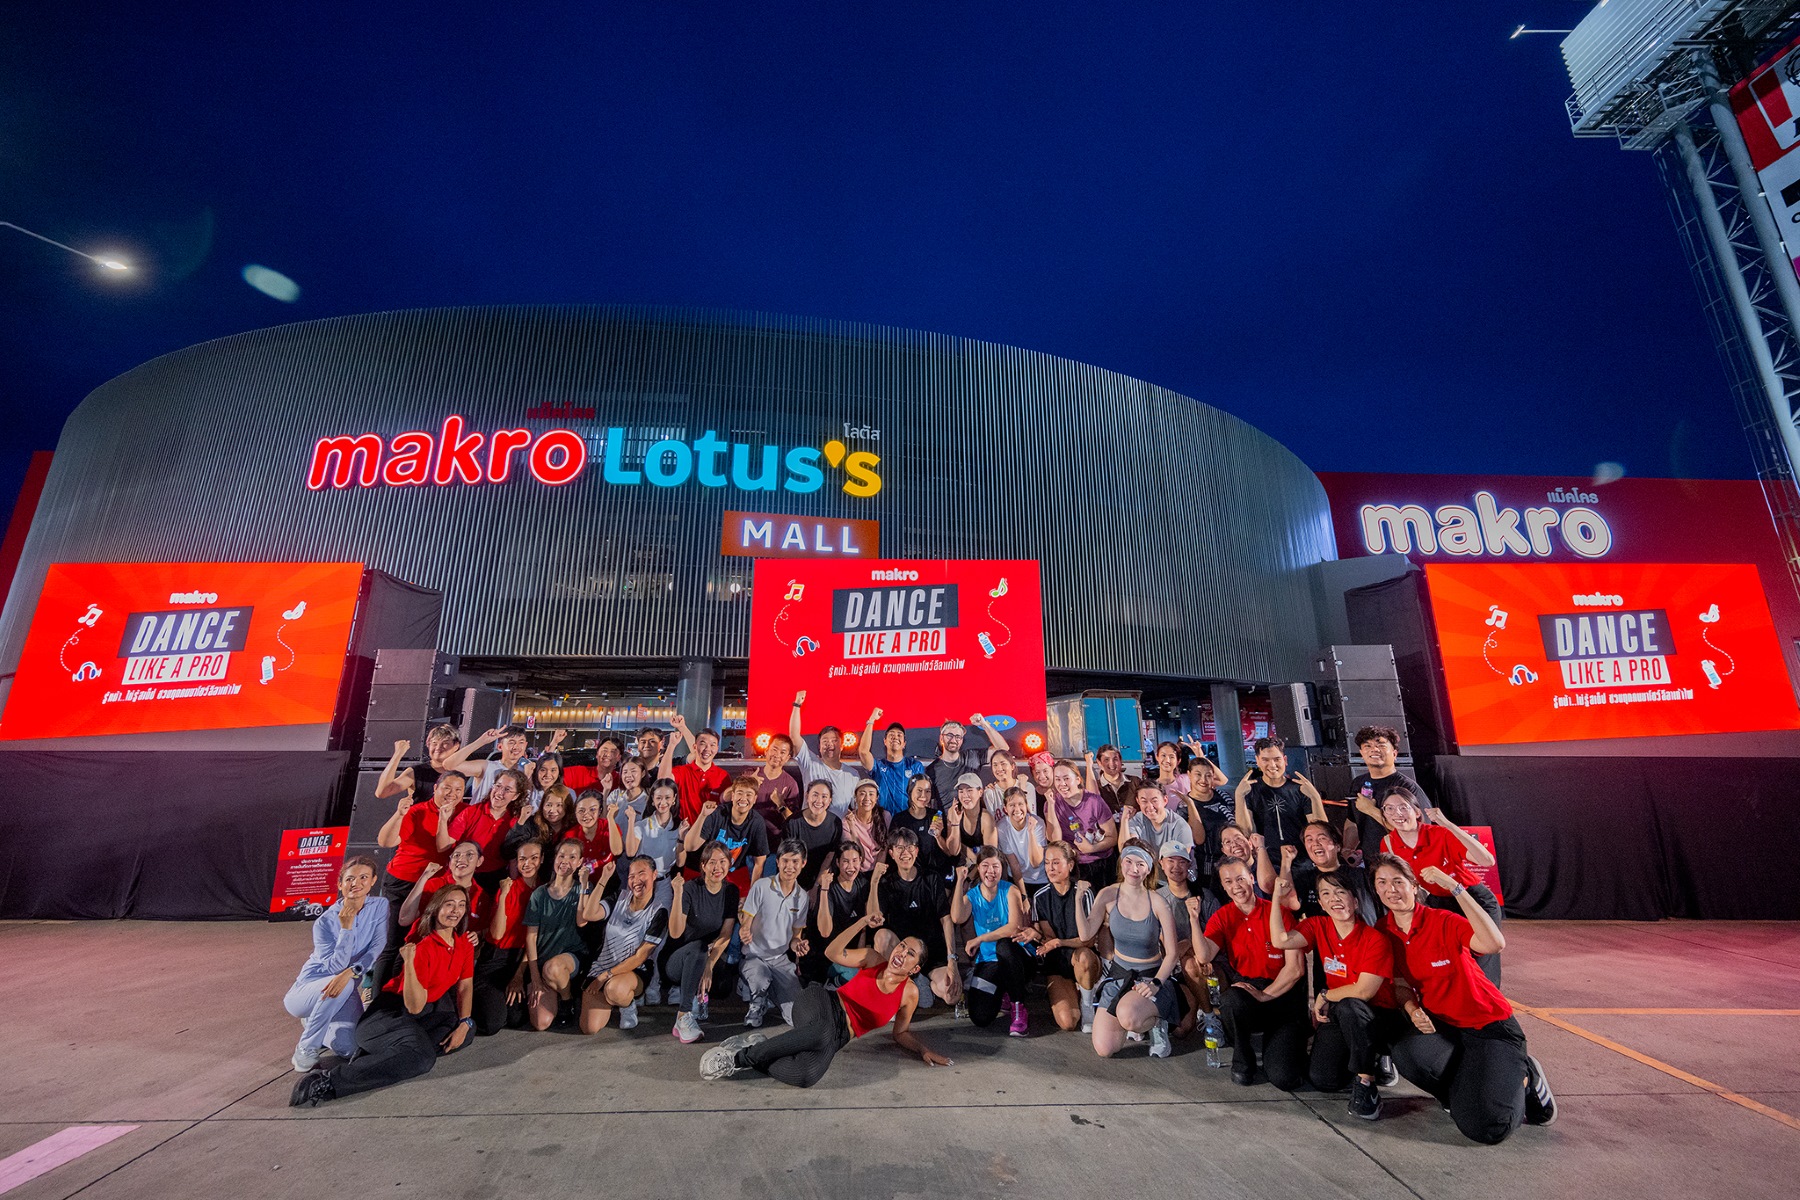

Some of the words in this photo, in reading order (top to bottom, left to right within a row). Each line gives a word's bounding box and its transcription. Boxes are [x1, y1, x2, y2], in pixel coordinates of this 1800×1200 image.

[843, 423, 881, 441] โลตัส
[307, 414, 587, 491] makro
[602, 426, 882, 498] Lotus's
[1546, 487, 1599, 504] แม็คโคร
[742, 519, 860, 554] MALL
[1360, 491, 1613, 558] makro
[870, 568, 919, 582] makro
[169, 590, 218, 604] makro
[844, 588, 945, 629] DANCE
[1572, 592, 1624, 606] makro
[131, 611, 240, 653] DANCE
[849, 632, 886, 655] LIKE
[891, 632, 901, 653] A
[908, 630, 941, 653] PRO
[1555, 613, 1658, 656] DANCE
[128, 657, 167, 681] LIKE
[171, 656, 183, 678] A
[187, 653, 224, 678] PRO
[1568, 661, 1605, 685] LIKE
[1613, 660, 1622, 682] A
[1629, 657, 1661, 681] PRO
[301, 835, 329, 848] DANCE
